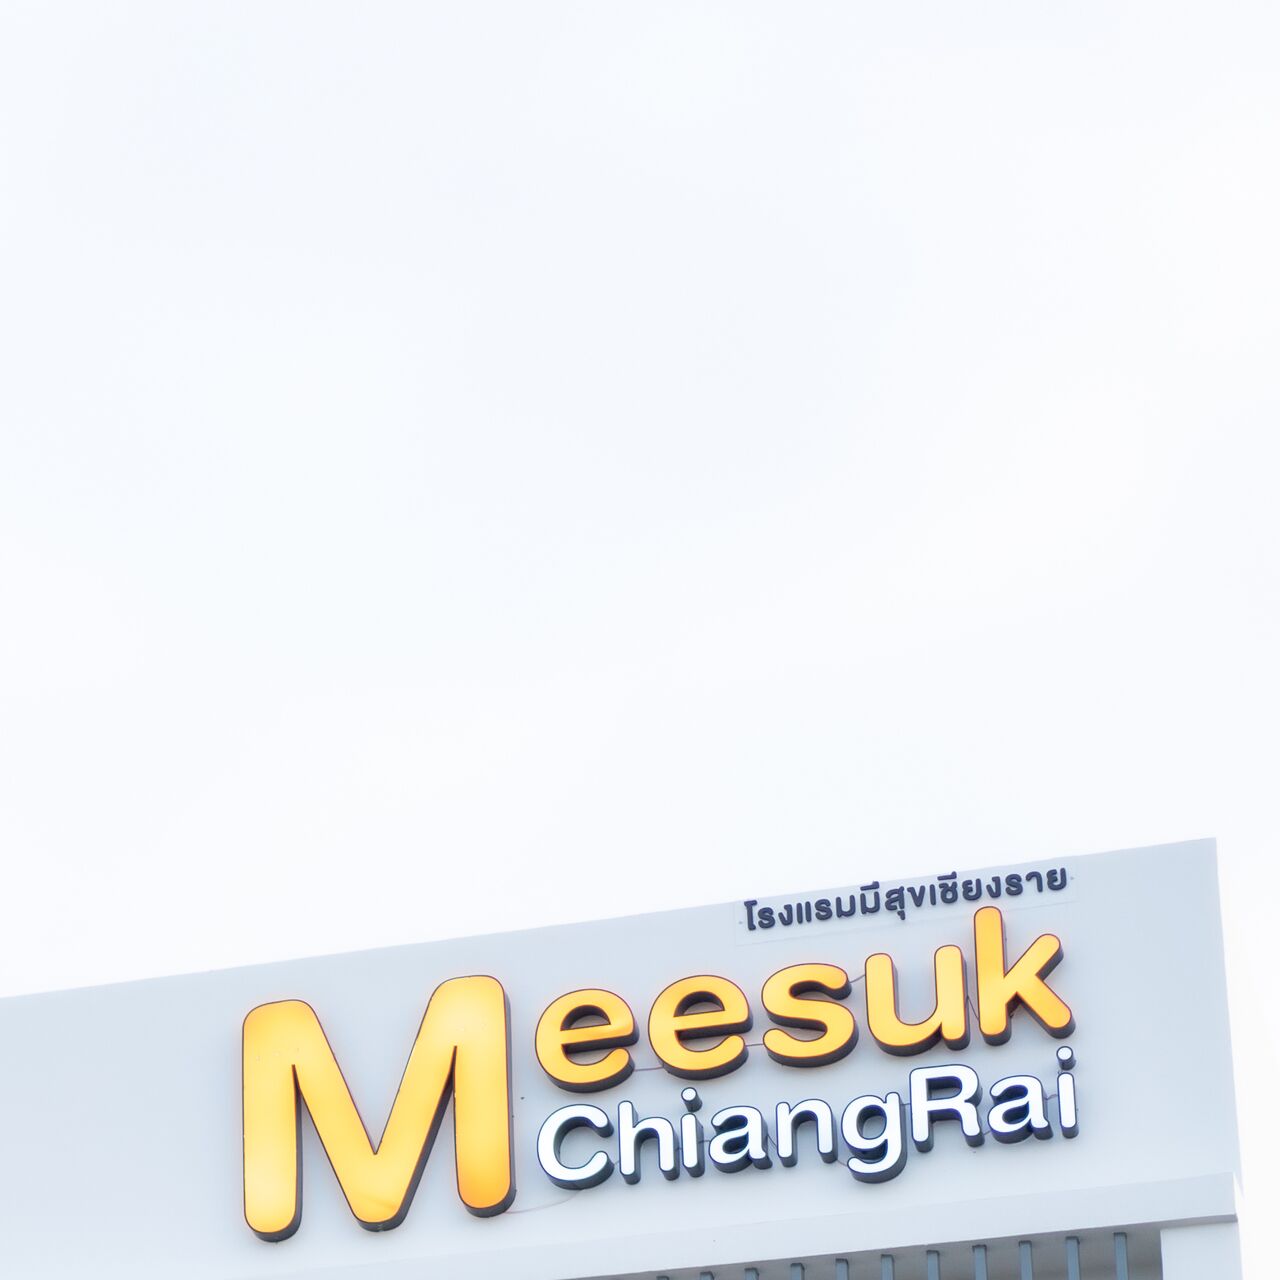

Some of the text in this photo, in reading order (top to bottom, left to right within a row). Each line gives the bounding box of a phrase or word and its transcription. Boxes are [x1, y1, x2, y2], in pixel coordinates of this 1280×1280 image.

[744, 867, 1067, 931] โรงแรมมีสุขเชียงราย
[242, 906, 1075, 1242] Meesuk
[536, 1046, 1078, 1183] ChiangRai
